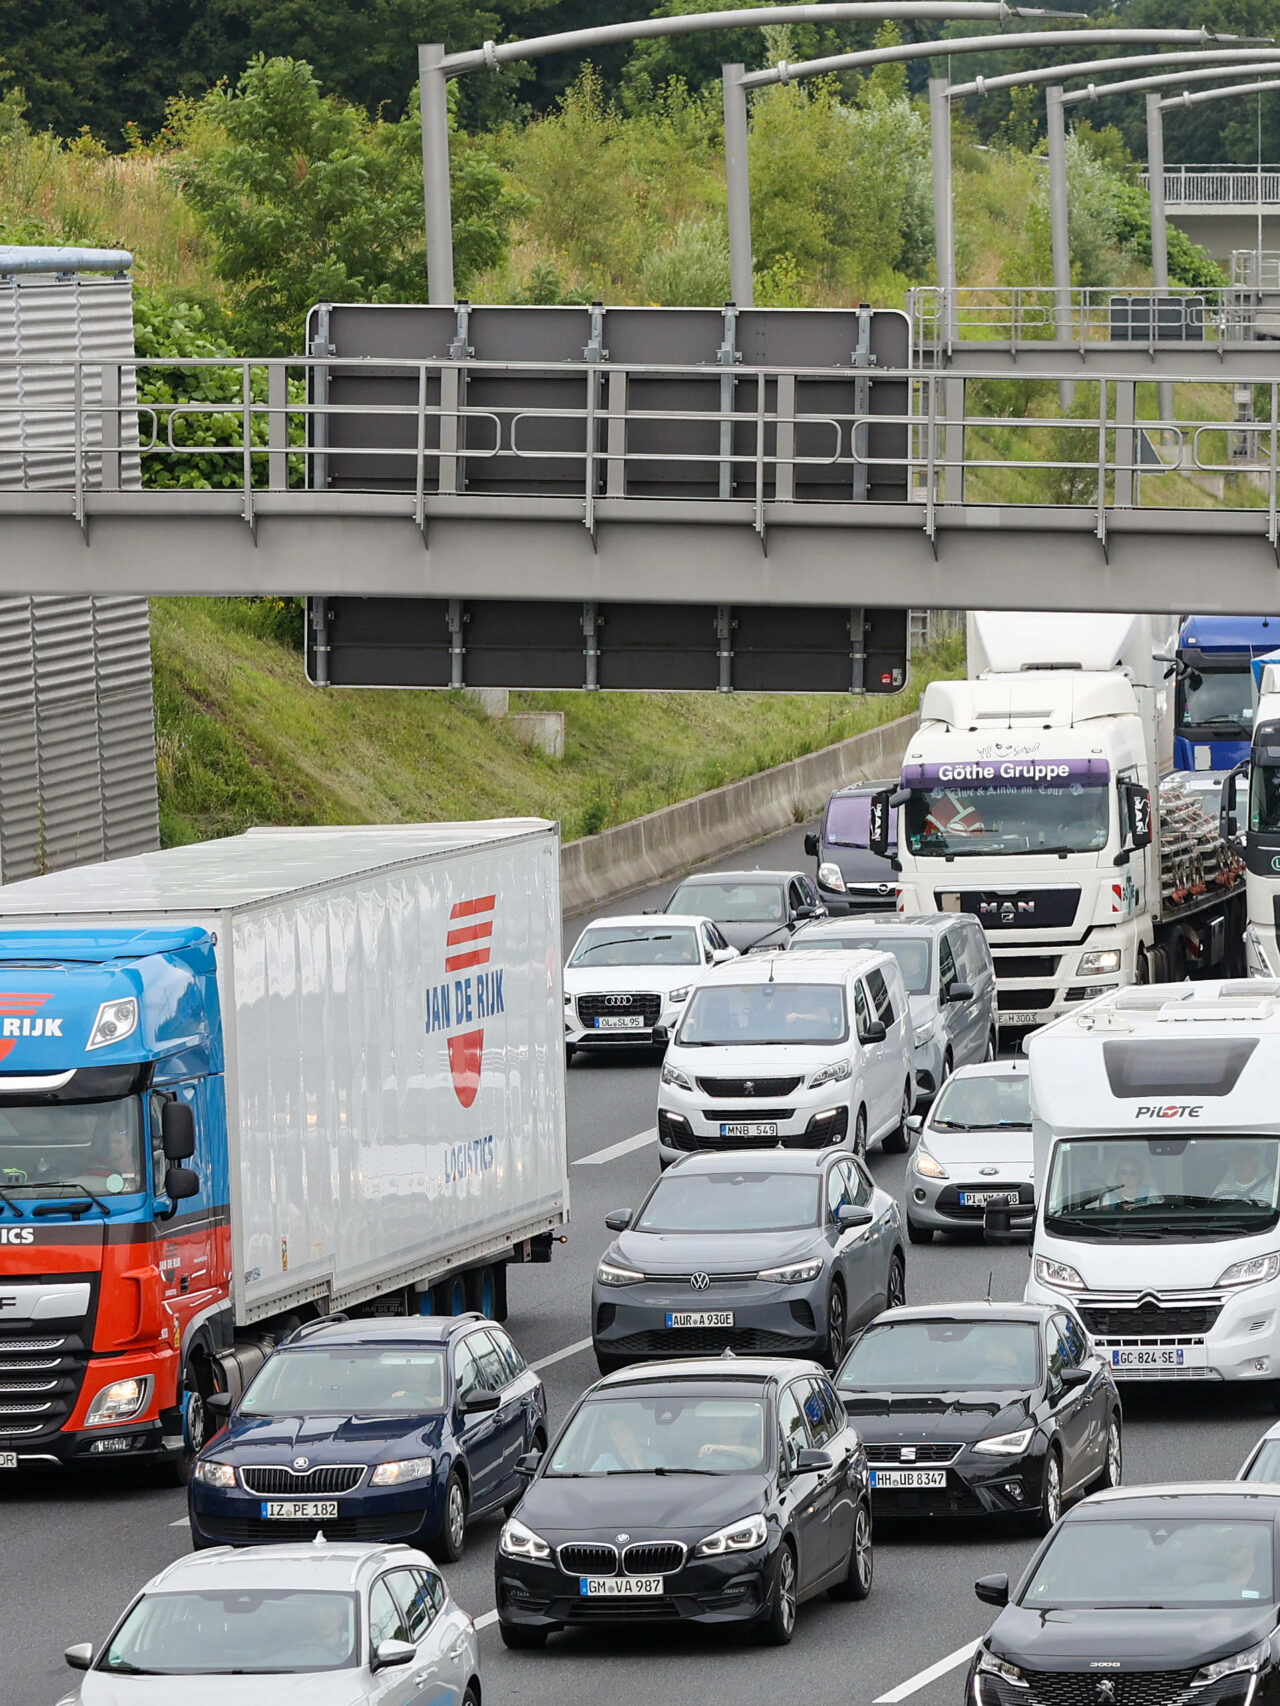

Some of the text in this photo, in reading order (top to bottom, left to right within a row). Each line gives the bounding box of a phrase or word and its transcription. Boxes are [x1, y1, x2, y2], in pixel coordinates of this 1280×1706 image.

[937, 762, 1070, 782] Göthe Gruppe
[1133, 796, 1144, 835] MAN
[979, 901, 1035, 914] MAN
[425, 968, 505, 1035] JAN DE RIJK
[601, 1017, 640, 1027] OL SL 95
[1008, 1014, 1015, 1023] H
[3, 1018, 64, 1037] RIJK
[727, 1125, 775, 1135] MNB 549
[966, 1194, 977, 1204] PI
[673, 1313, 732, 1326] AUR A 930E
[877, 1472, 944, 1486] HH UB 8347
[268, 1503, 336, 1516] IZ PE 182
[588, 1579, 660, 1594] GM VA 987
